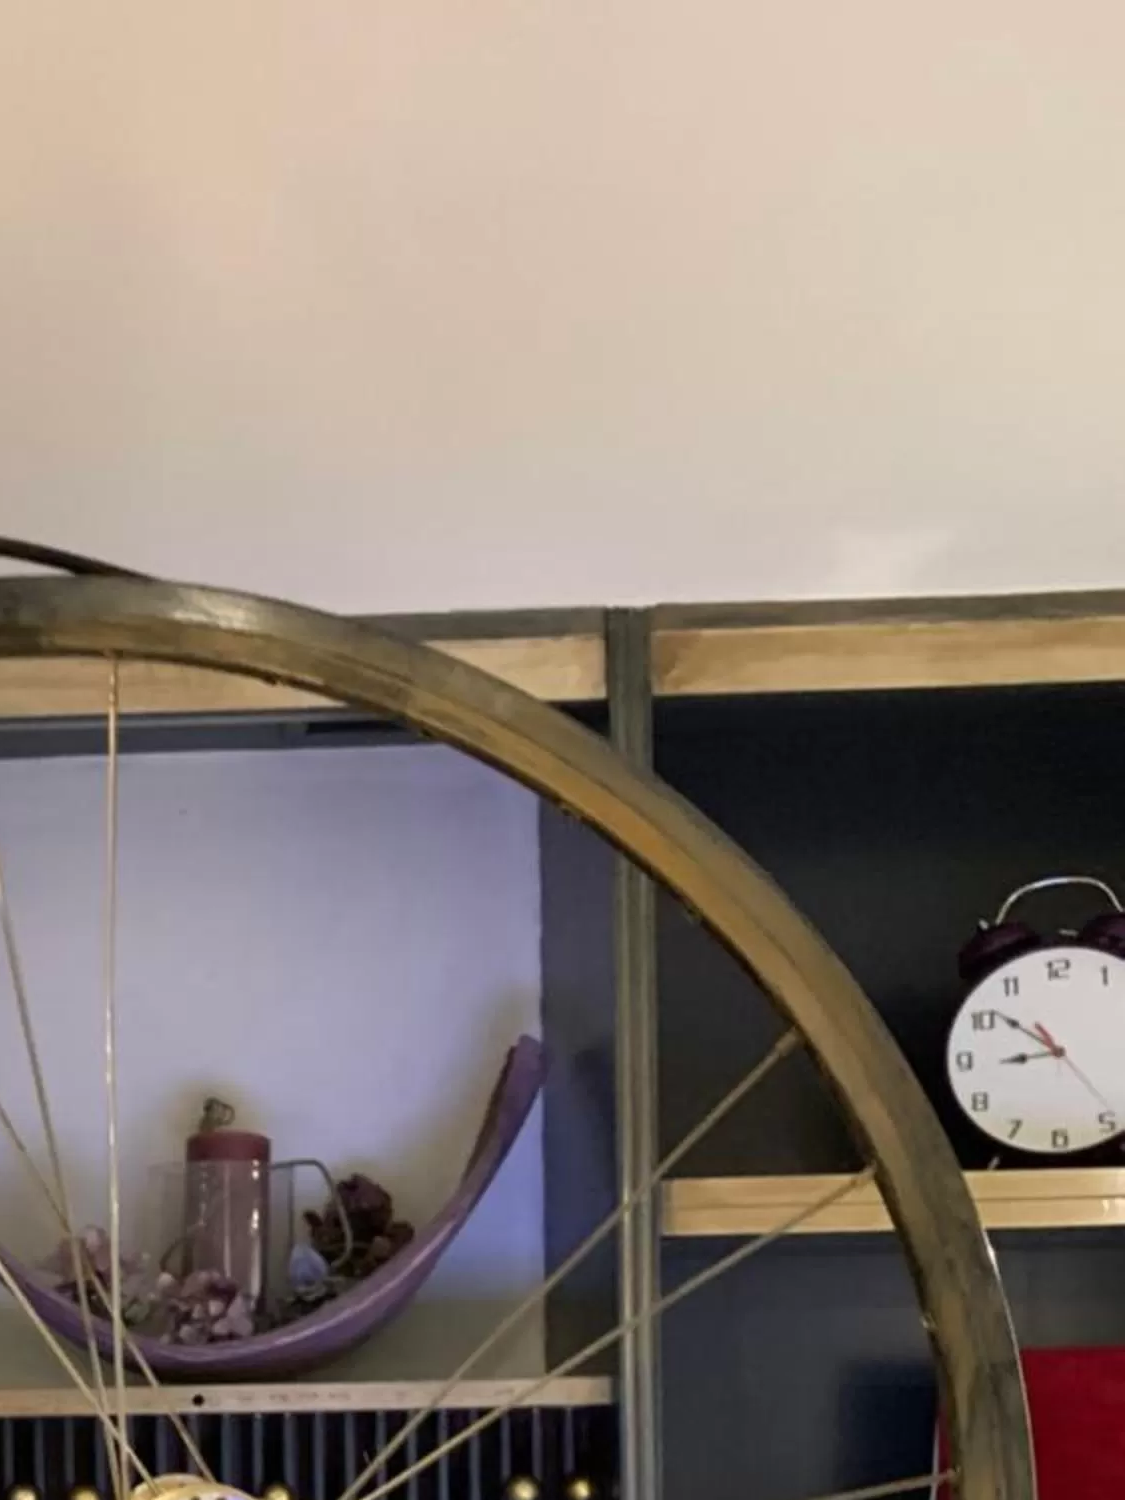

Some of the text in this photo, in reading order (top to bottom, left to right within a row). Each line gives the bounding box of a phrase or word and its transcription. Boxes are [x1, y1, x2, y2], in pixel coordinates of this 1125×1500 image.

[1045, 959, 1070, 981] 12
[1100, 966, 1109, 986] 1
[1003, 976, 1020, 996] 11
[971, 1010, 996, 1031] 10
[956, 1051, 973, 1072] 9
[972, 1092, 988, 1112] 8
[1008, 1120, 1022, 1139] 7
[1098, 1112, 1116, 1133] 5
[1051, 1129, 1068, 1149] 6
